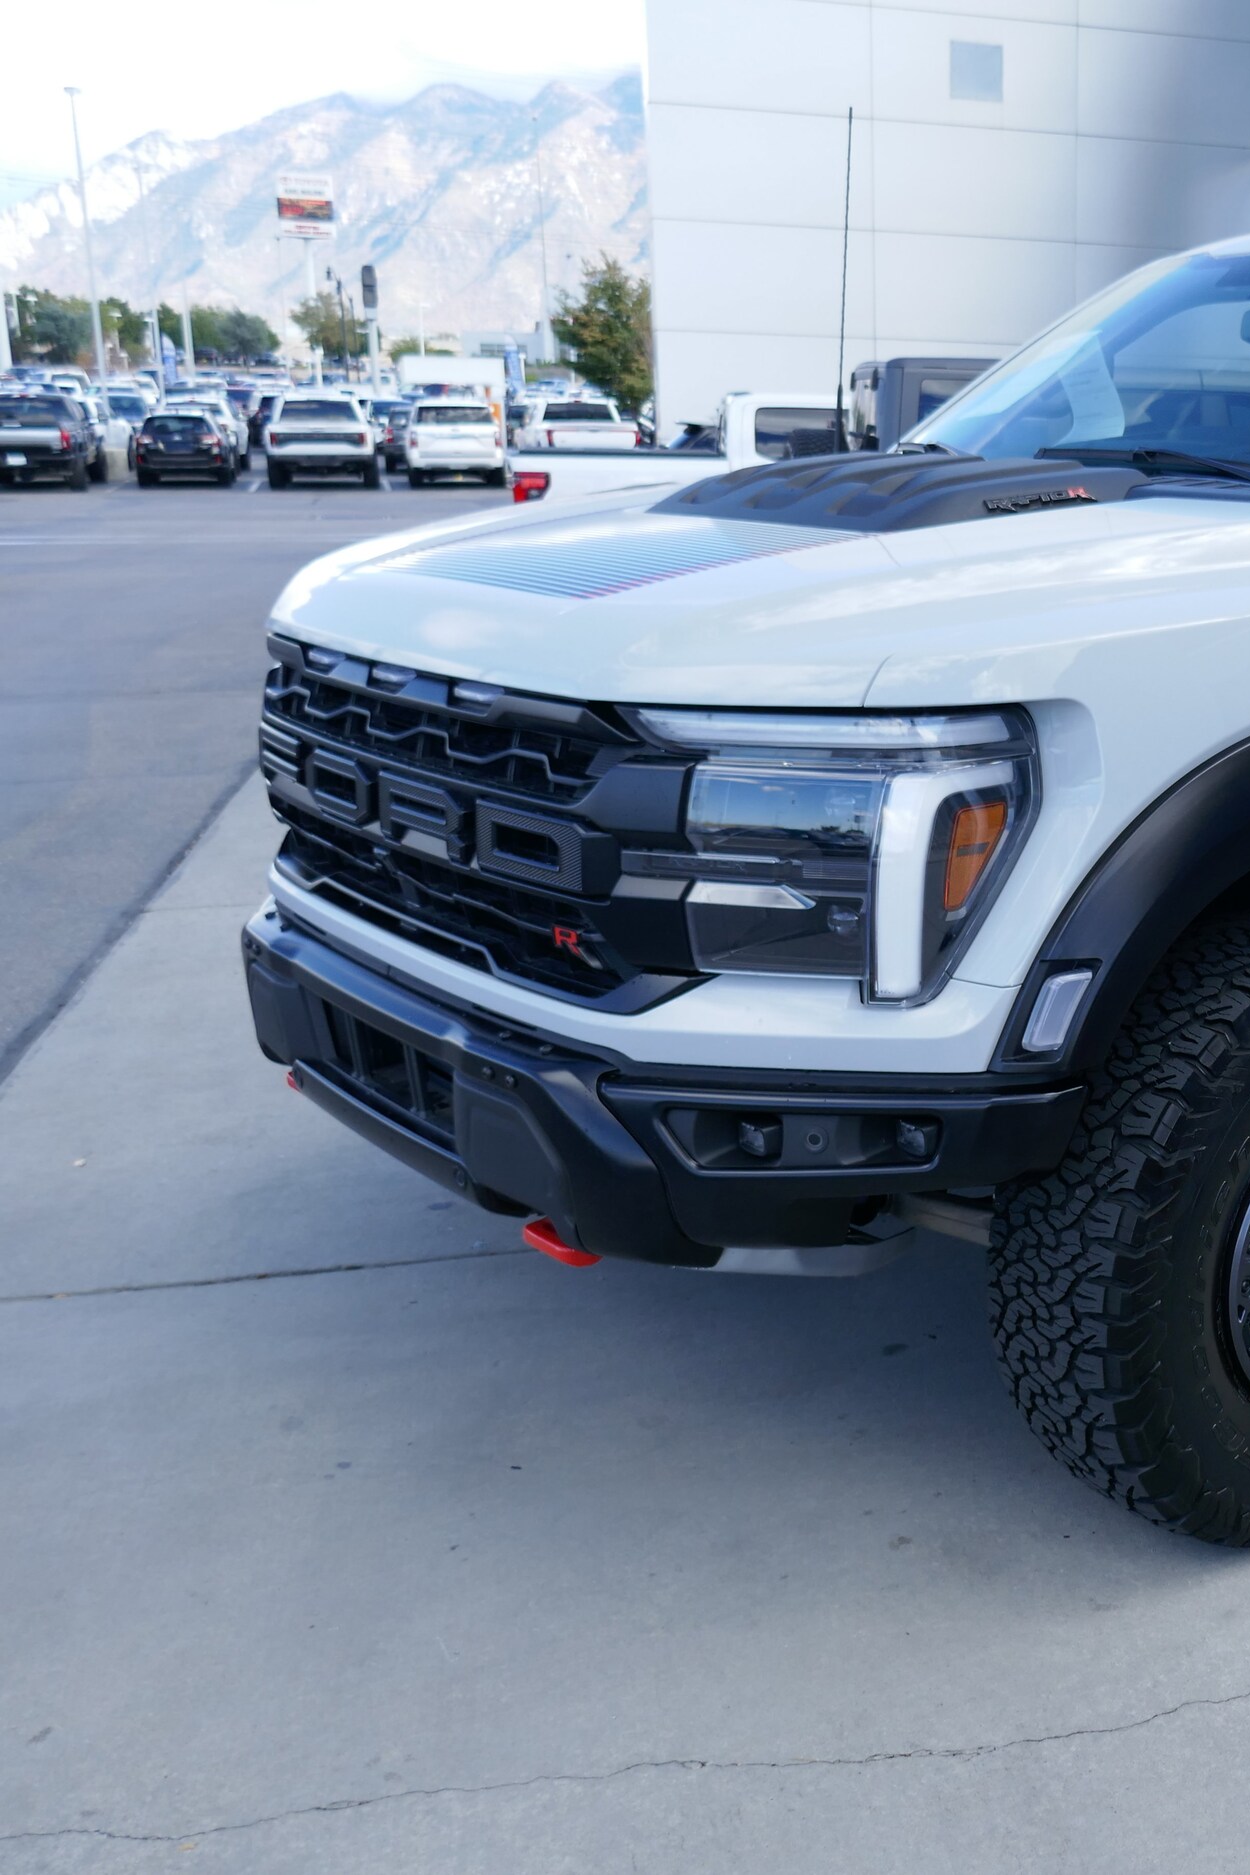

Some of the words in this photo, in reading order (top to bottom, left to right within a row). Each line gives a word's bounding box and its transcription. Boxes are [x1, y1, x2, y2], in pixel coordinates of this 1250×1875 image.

[982, 487, 1097, 512] RAPTOR
[259, 722, 597, 893] FORD
[553, 926, 594, 963] R
